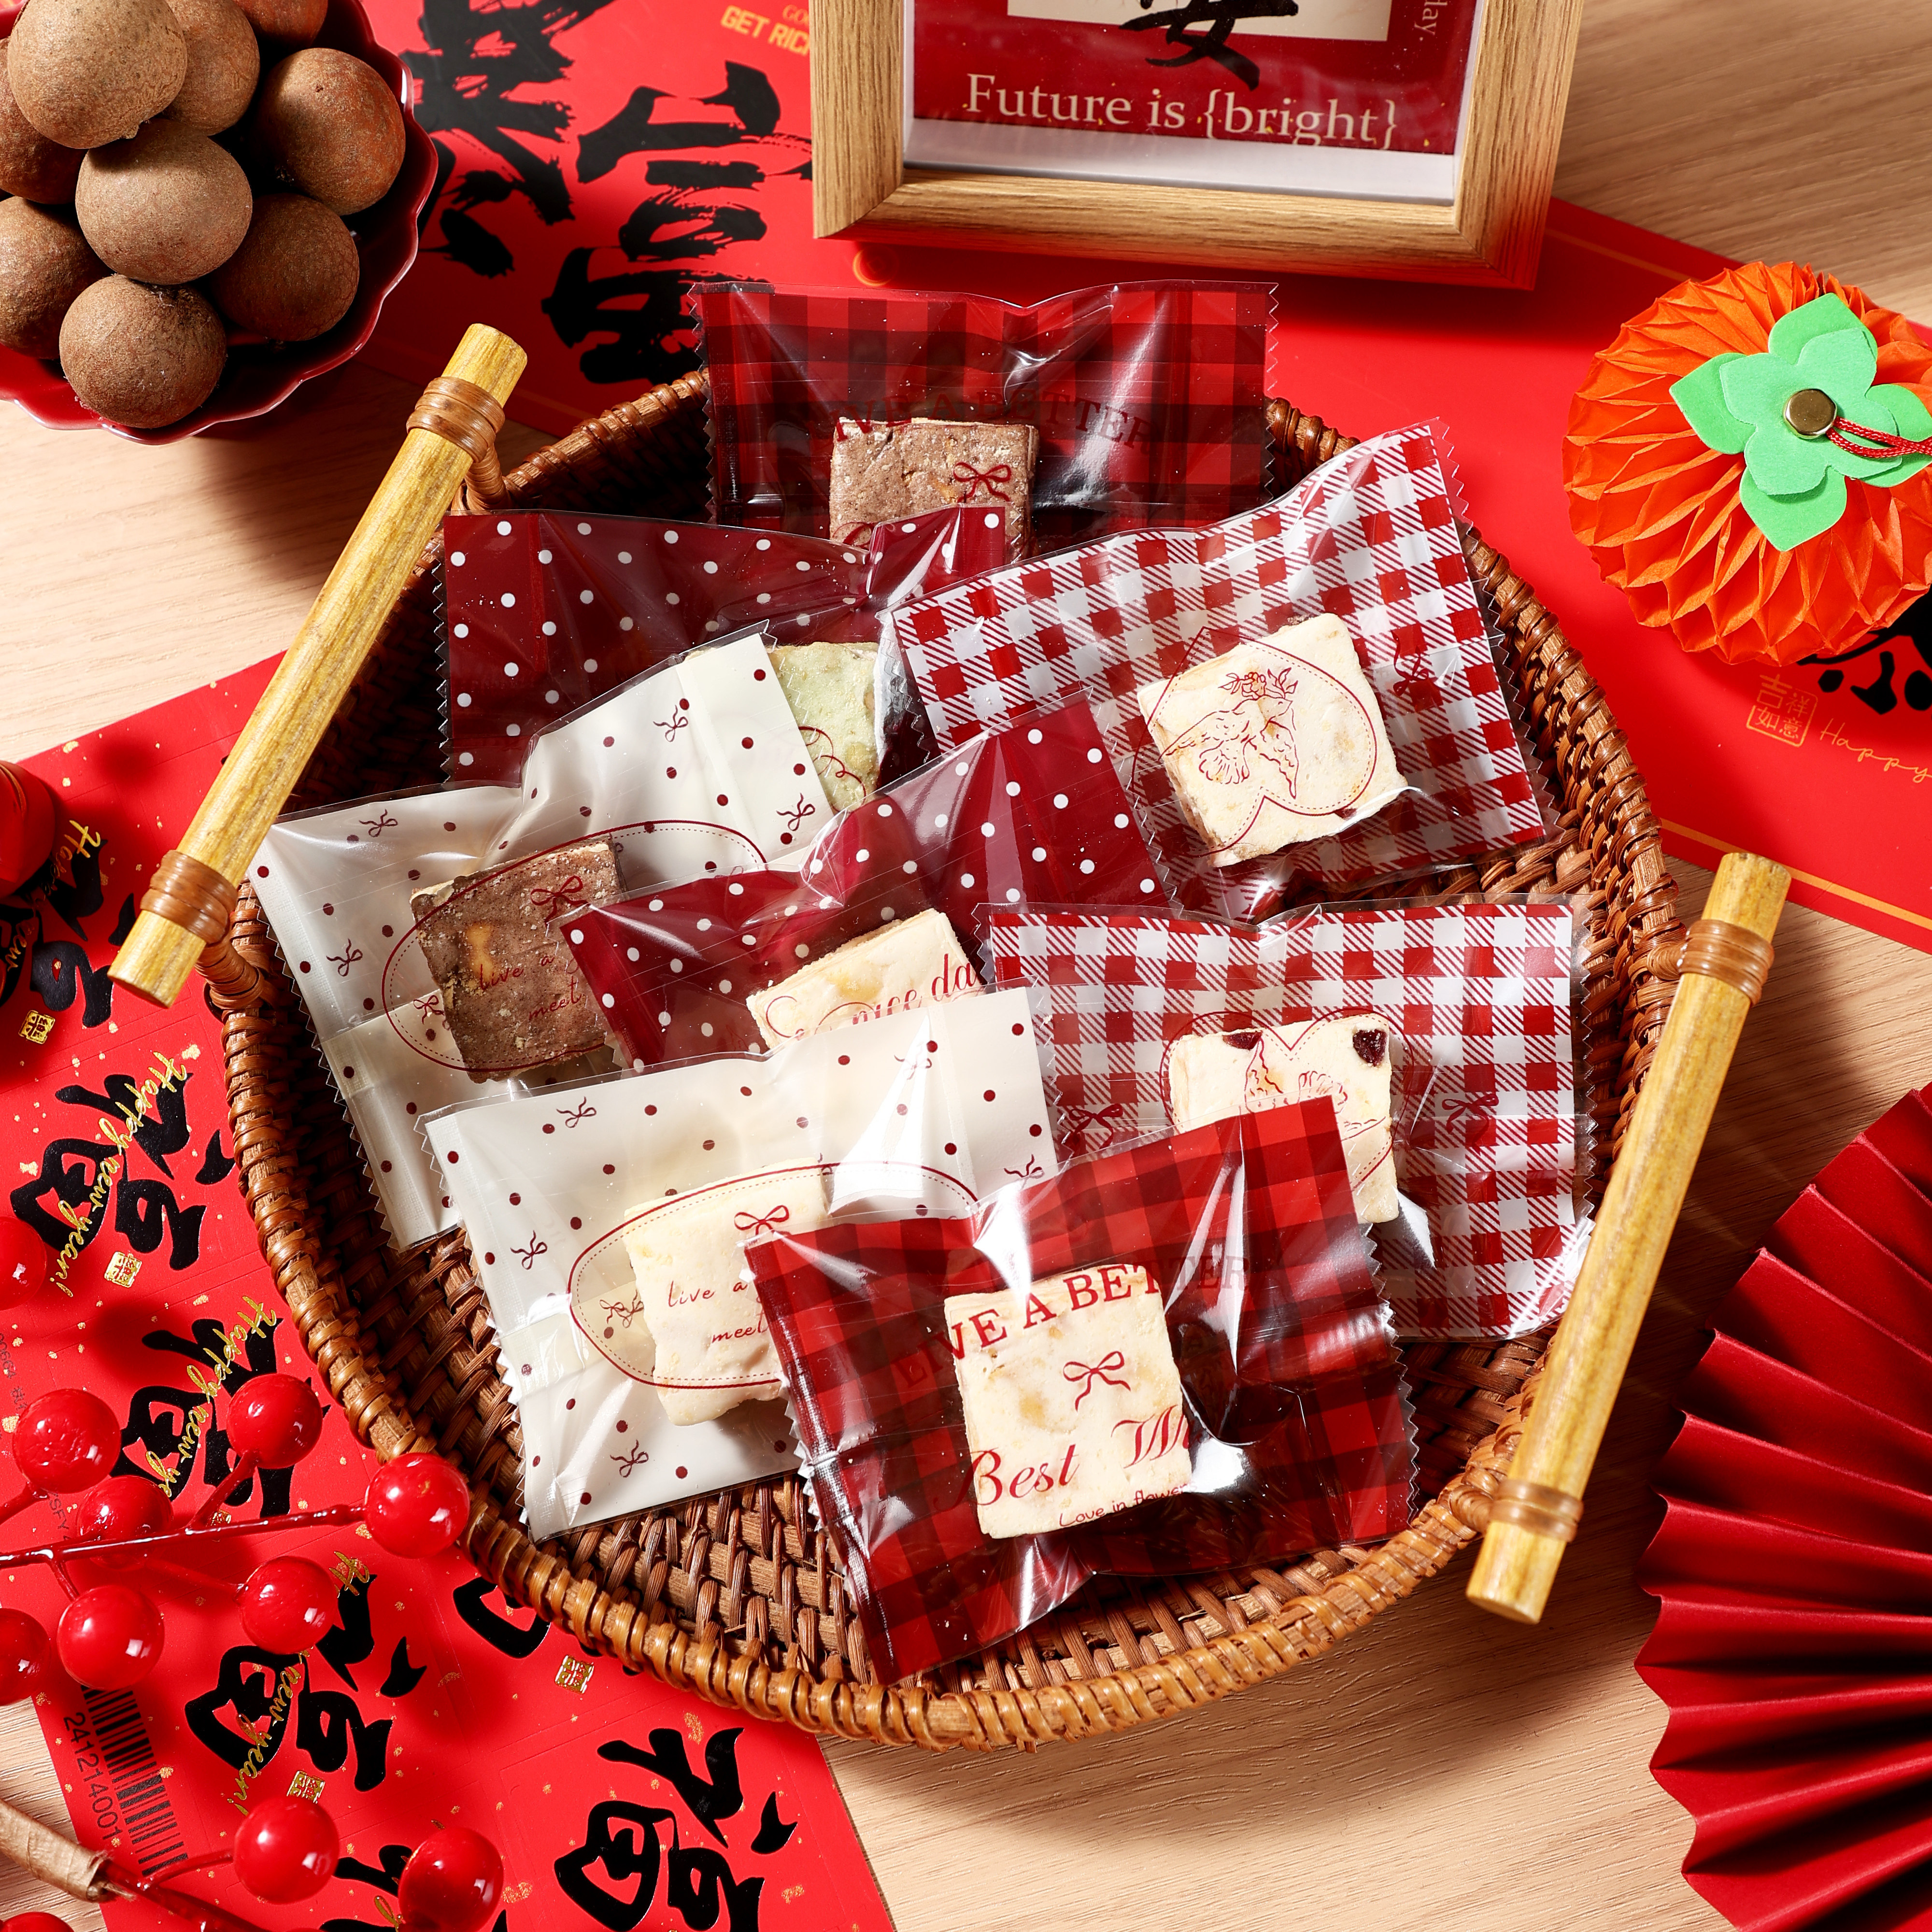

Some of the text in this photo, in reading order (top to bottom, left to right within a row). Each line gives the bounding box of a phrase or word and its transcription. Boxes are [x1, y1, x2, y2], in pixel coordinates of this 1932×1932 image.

[721, 5, 770, 38] GET
[966, 73, 1397, 150] Future is {bright}
[1820, 718, 1932, 783] Happy
[480, 964, 524, 990] live
[528, 976, 582, 1021] meet
[931, 953, 984, 1002] da
[99, 1051, 187, 1155] Happy
[91, 1156, 121, 1212] new
[668, 1280, 716, 1307] live
[891, 1308, 1008, 1388] LIVE
[1023, 1292, 1057, 1329] A
[178, 1295, 277, 1463] Happy new
[933, 1443, 1080, 1512] Best
[1059, 1507, 1105, 1527] Love
[1112, 1500, 1128, 1513] in
[270, 1665, 301, 1726] new
[63, 1712, 121, 1839] 241214001
